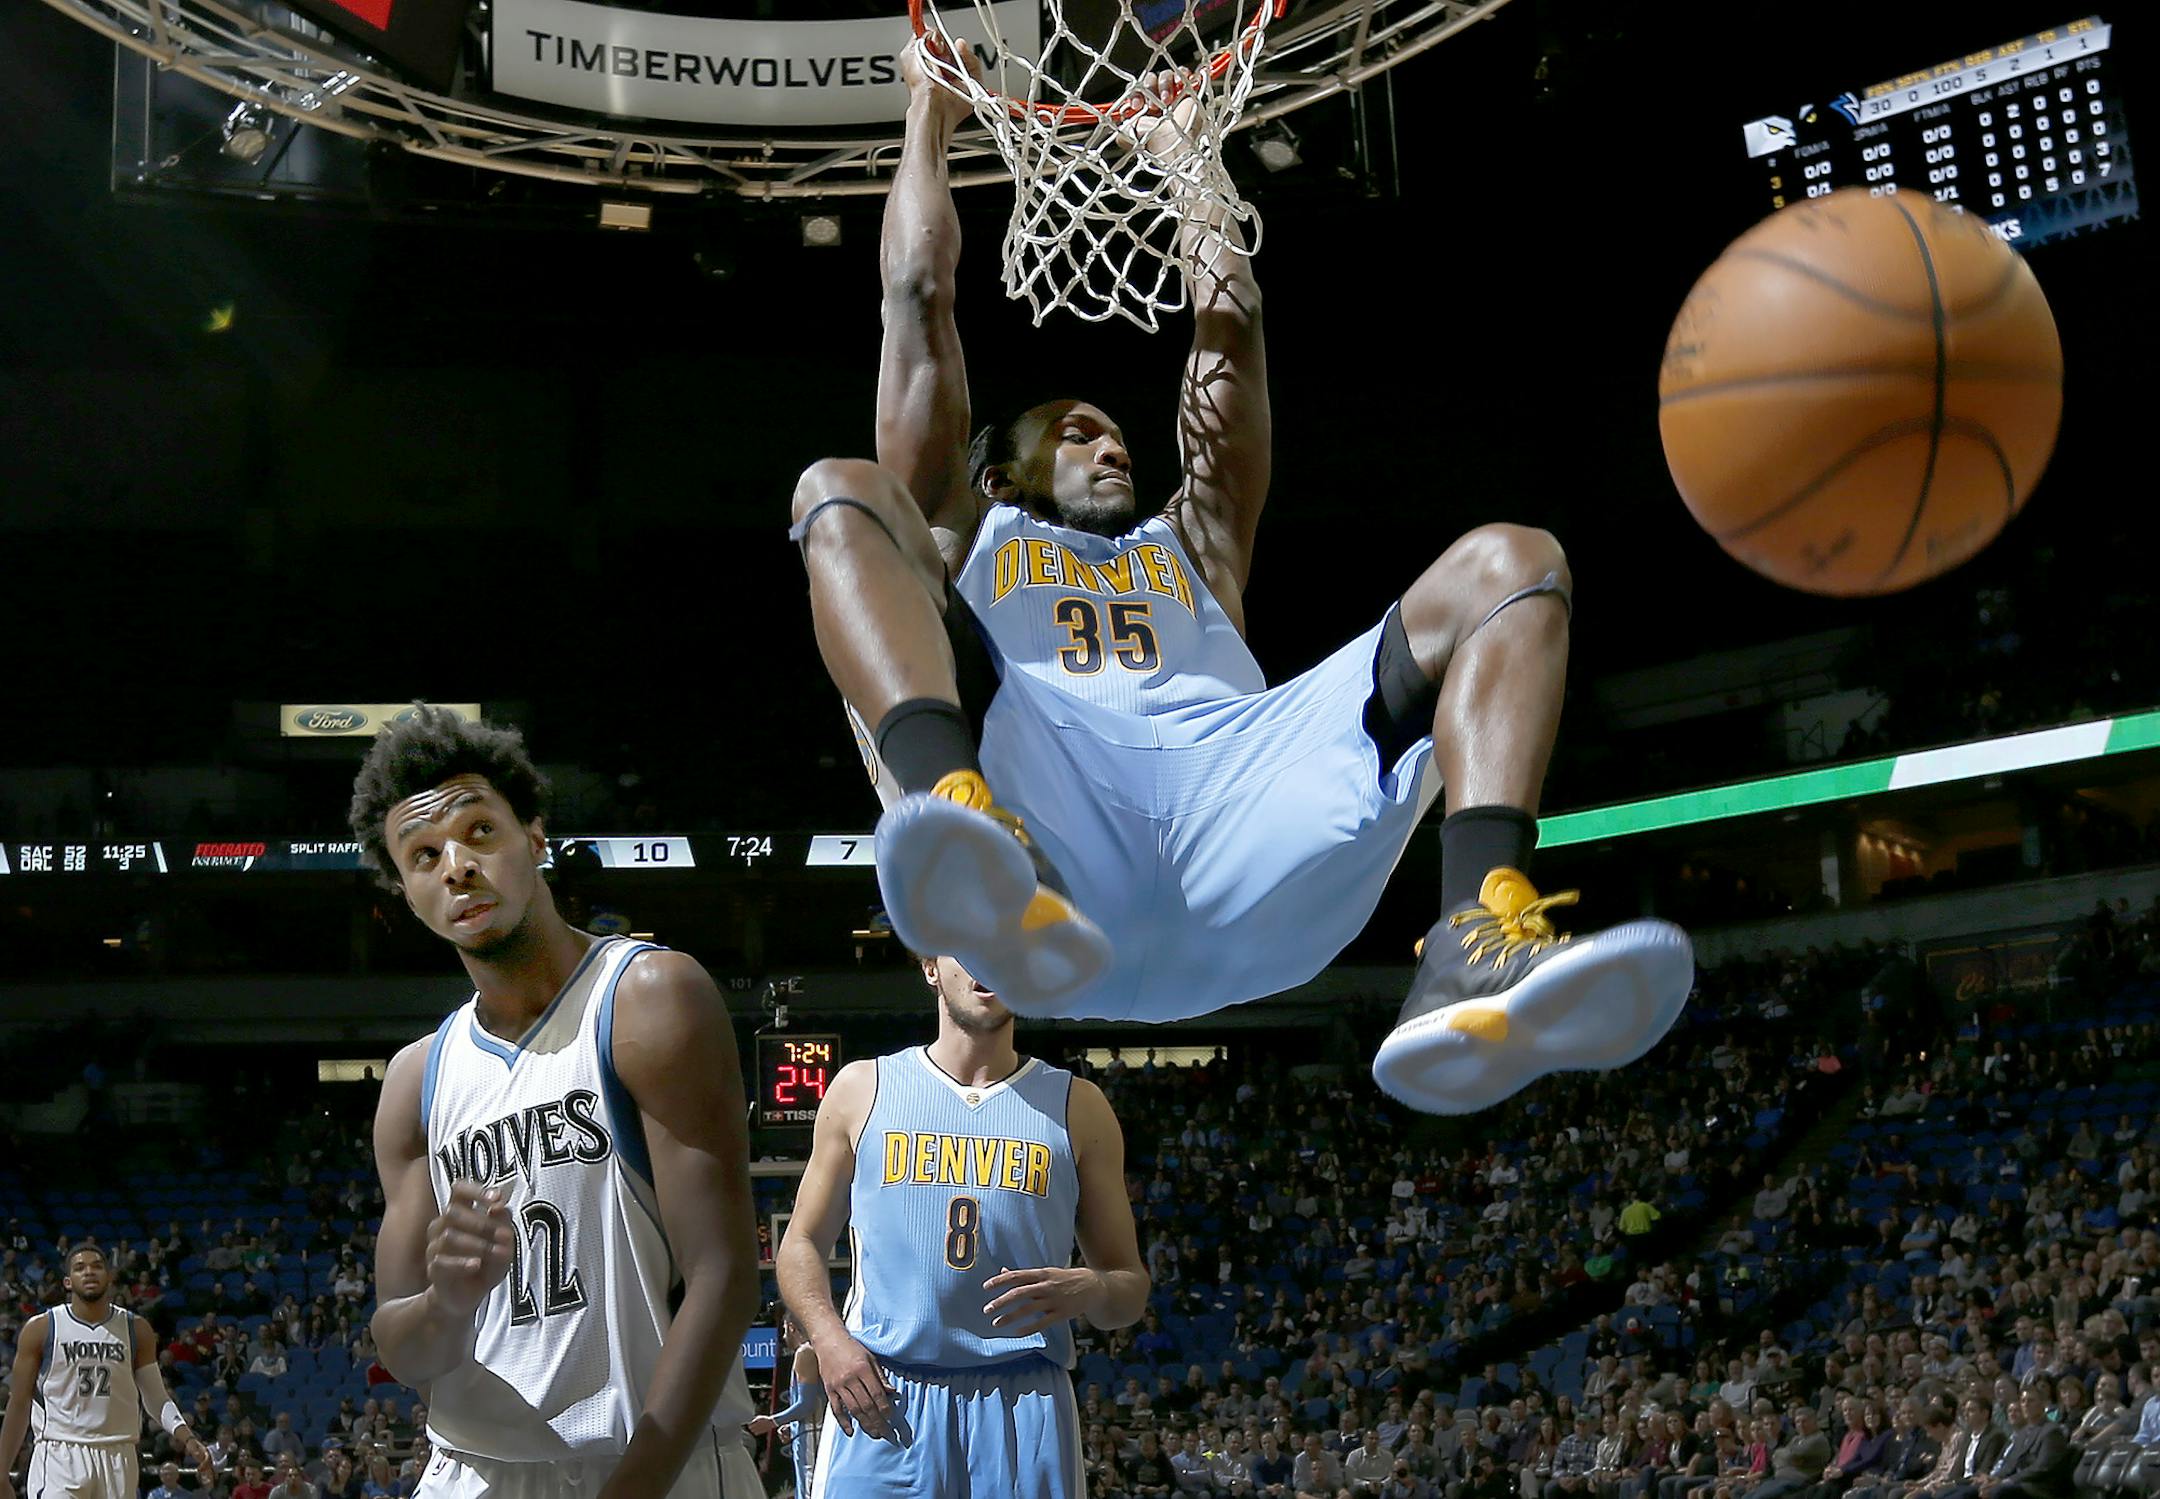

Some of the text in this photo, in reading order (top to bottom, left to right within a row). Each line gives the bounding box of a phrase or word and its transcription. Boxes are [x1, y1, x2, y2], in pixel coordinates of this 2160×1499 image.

[526, 30, 1008, 88] TIMBERWOLVES.M
[1870, 37, 2088, 115] 30 0 100 5 2 1 1
[1998, 82, 2020, 97] AST
[1770, 79, 2099, 189] 3 0/0 0/0 0/0 0 2 0 0 0
[1807, 182, 1832, 199] 0/1
[1866, 163, 1894, 181] 0/0
[1926, 144, 1954, 164] 0/0
[1983, 133, 1996, 147] 0
[2009, 124, 2022, 138] 0
[2036, 116, 2049, 130] 0
[2063, 109, 2076, 123] 0
[2090, 100, 2103, 114] 0
[1929, 164, 1958, 184] 0/0
[1986, 153, 1999, 167] 0
[2013, 144, 2026, 158] 0
[2039, 136, 2052, 150] 0
[2066, 129, 2079, 143] 0
[2093, 121, 2106, 135] 0
[1989, 172, 2002, 186] 0
[2016, 165, 2029, 179] 0
[2042, 157, 2055, 171] 0
[2069, 150, 2082, 164] 0
[2096, 141, 2109, 156] 3
[1992, 162, 2112, 207] 0 0 5 0 7
[989, 536, 1197, 621] DENVER
[1054, 596, 1162, 677] 35
[308, 711, 354, 729] Ford
[21, 845, 146, 859] SAC 52 11:25
[64, 857, 86, 871] 58
[194, 842, 267, 857] FEDERATED
[290, 843, 325, 855] SPLIT
[633, 843, 669, 862] 10
[727, 837, 773, 857] 7:24
[840, 841, 858, 860] 7
[784, 1043, 829, 1063] 7:24
[776, 1066, 825, 1102] 24
[435, 1089, 612, 1192] WOLVES
[880, 1129, 1053, 1198] DENVER
[945, 1194, 979, 1271] 8
[60, 1340, 125, 1366] WOLVES
[78, 1365, 111, 1397] 32
